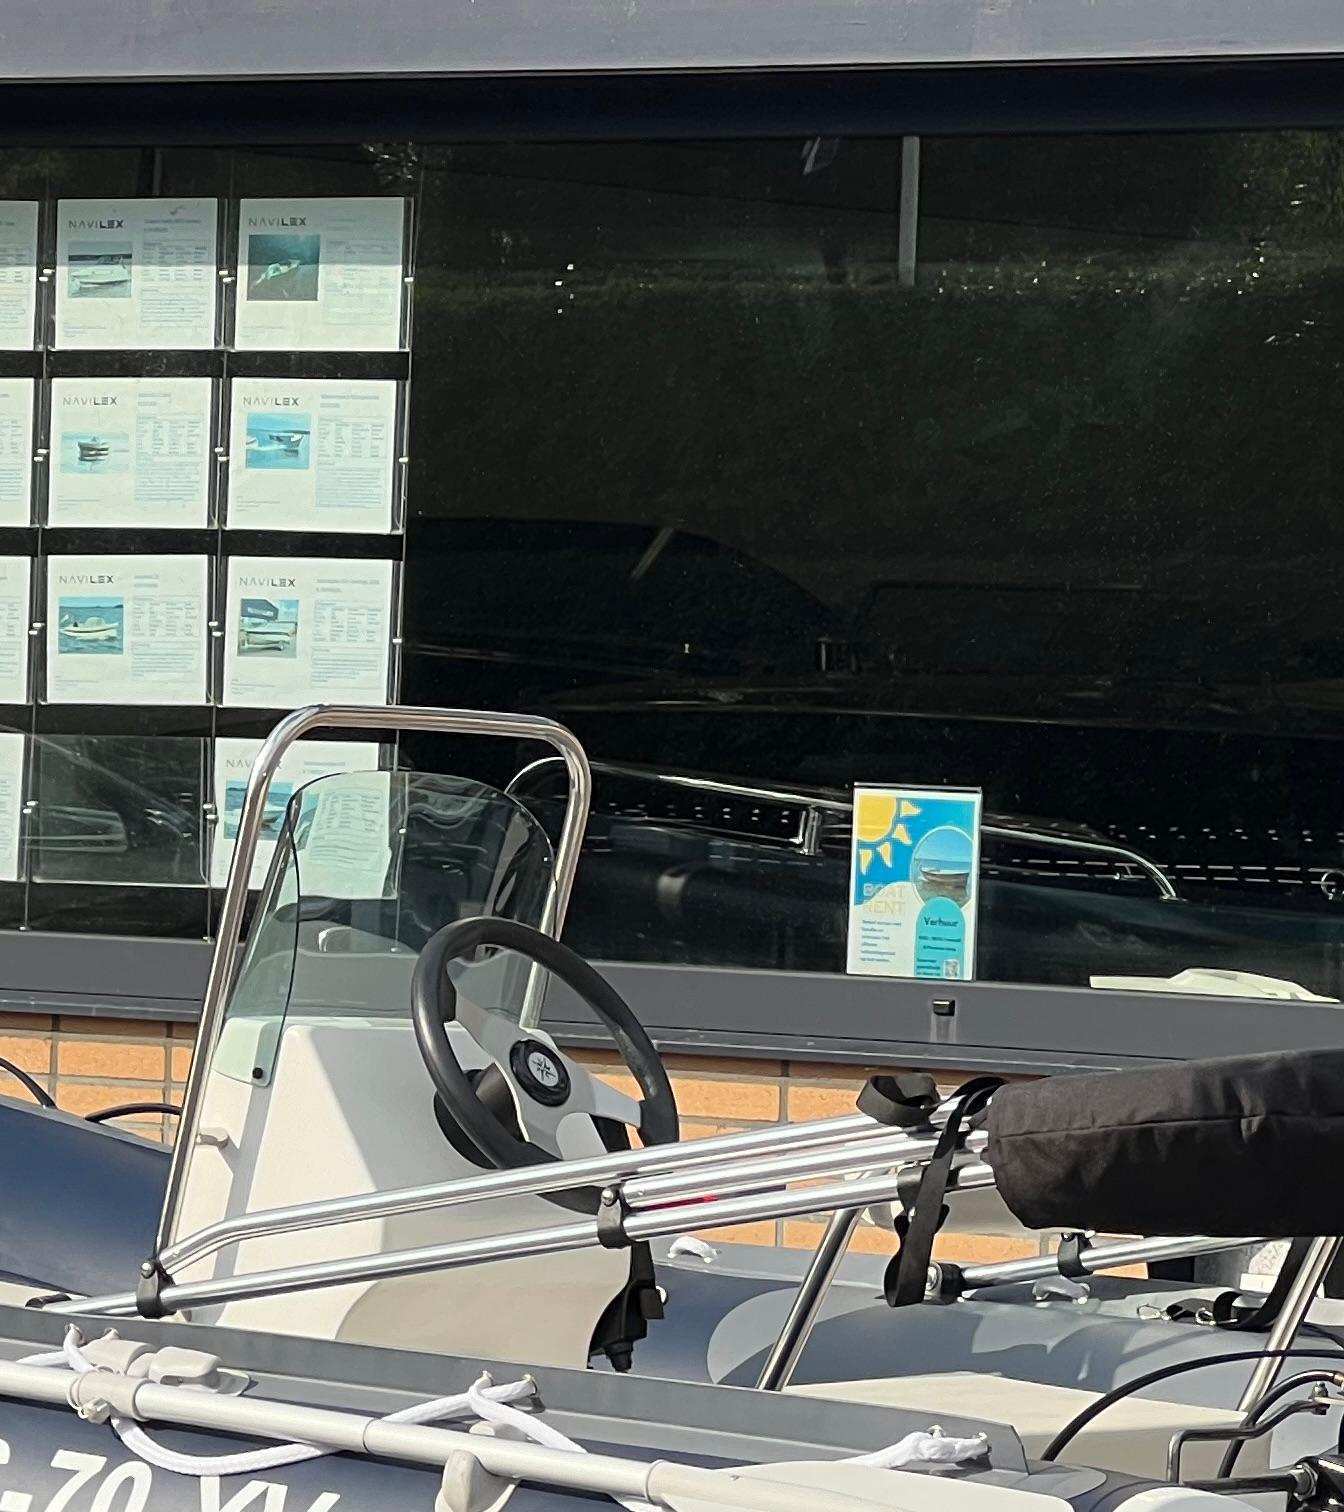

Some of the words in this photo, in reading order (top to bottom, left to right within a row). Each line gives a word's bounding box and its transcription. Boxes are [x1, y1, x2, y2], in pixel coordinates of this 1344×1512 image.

[69, 219, 124, 229] NAVILEX
[249, 217, 306, 227] NAVILEX
[63, 396, 117, 406] NAVILEX
[243, 396, 299, 406] NAVILEX
[59, 575, 114, 584] NAVILEX
[239, 577, 296, 587] NAVILEX
